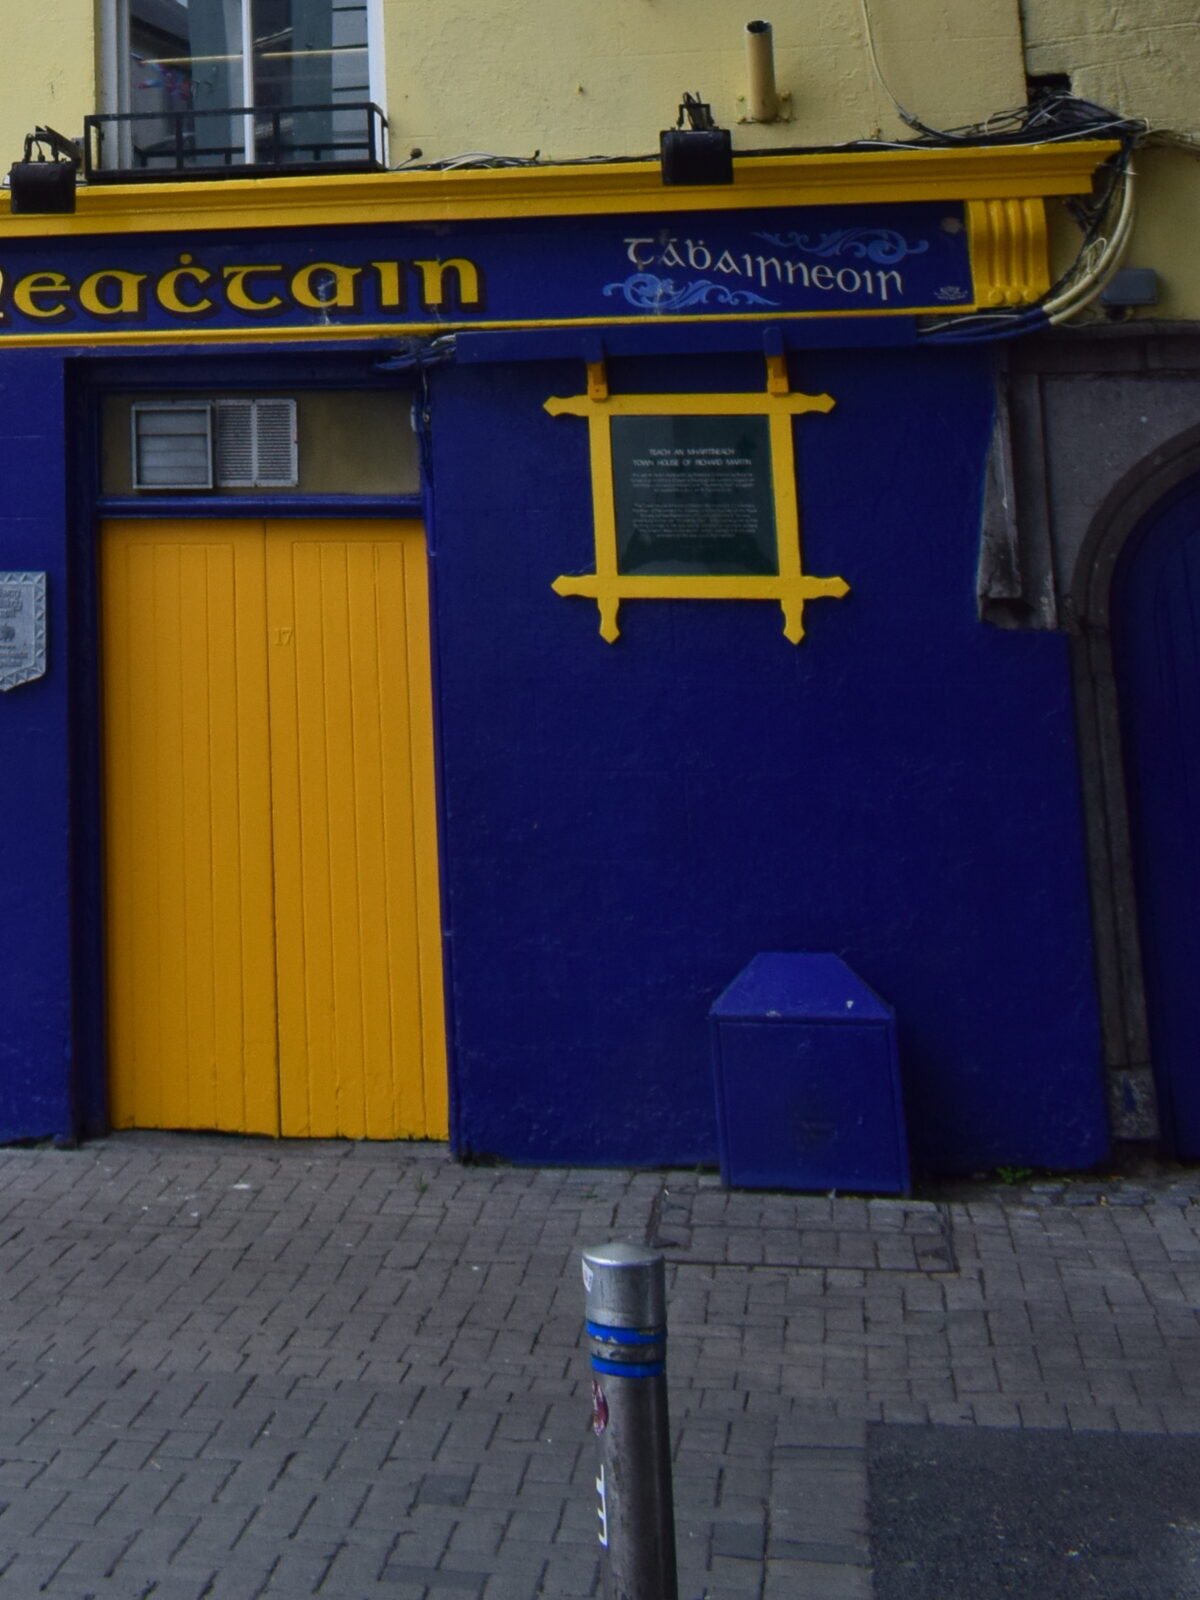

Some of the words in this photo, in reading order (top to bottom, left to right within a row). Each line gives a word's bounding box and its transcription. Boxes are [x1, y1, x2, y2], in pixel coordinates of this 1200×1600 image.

[632, 459, 655, 467] TOWN
[657, 458, 680, 467] HOUSE
[682, 458, 691, 467] OF
